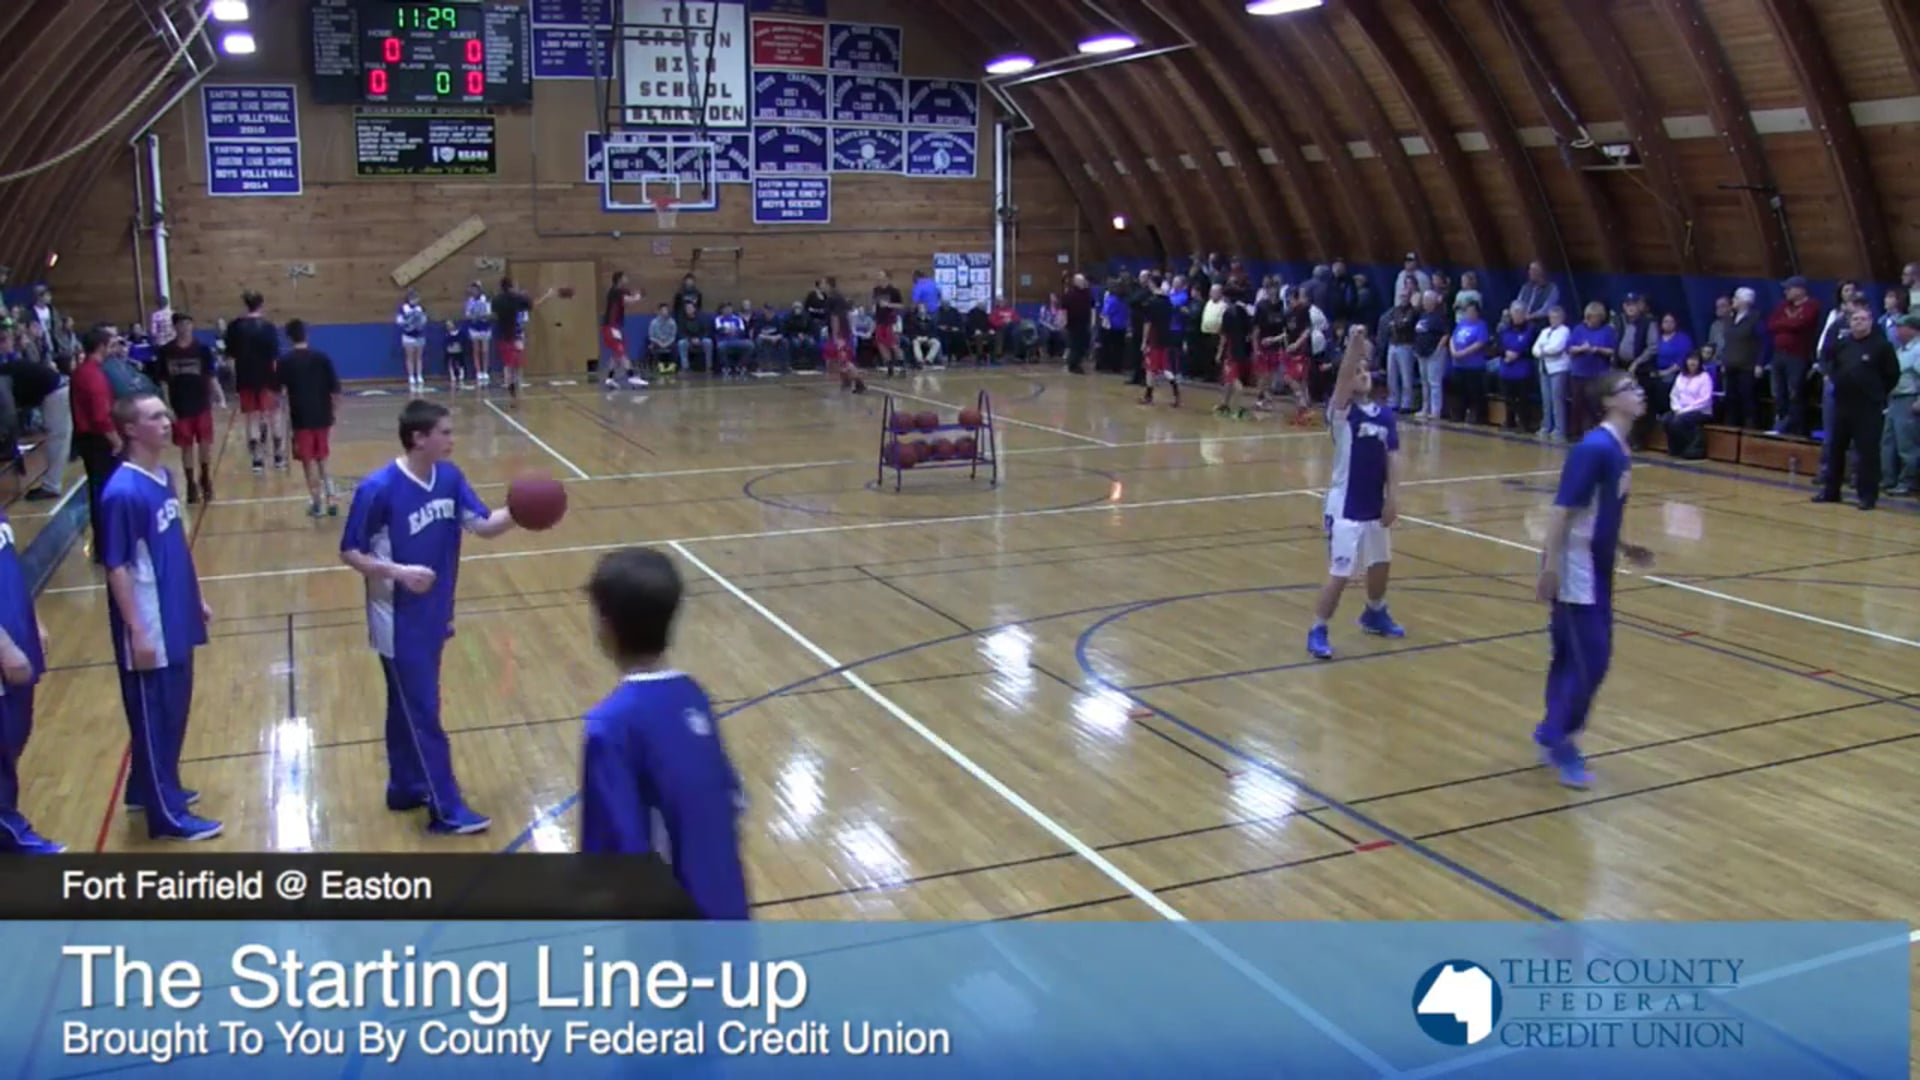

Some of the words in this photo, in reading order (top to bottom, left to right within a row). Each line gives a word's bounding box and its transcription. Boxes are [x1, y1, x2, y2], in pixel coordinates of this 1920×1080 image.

[450, 30, 477, 39] GUEST
[638, 30, 731, 48] EASTON
[384, 38, 401, 62] 0
[466, 39, 482, 63] 0
[369, 69, 387, 94] 0
[436, 71, 450, 94] 0
[467, 71, 483, 94] 0
[640, 81, 732, 98] SCHOOL
[210, 114, 234, 123] BOYS
[237, 114, 290, 123] VOLLEYBALL
[215, 169, 238, 178] BOYS
[240, 169, 294, 178] VOLLEYBALL
[762, 200, 785, 208] BOYS
